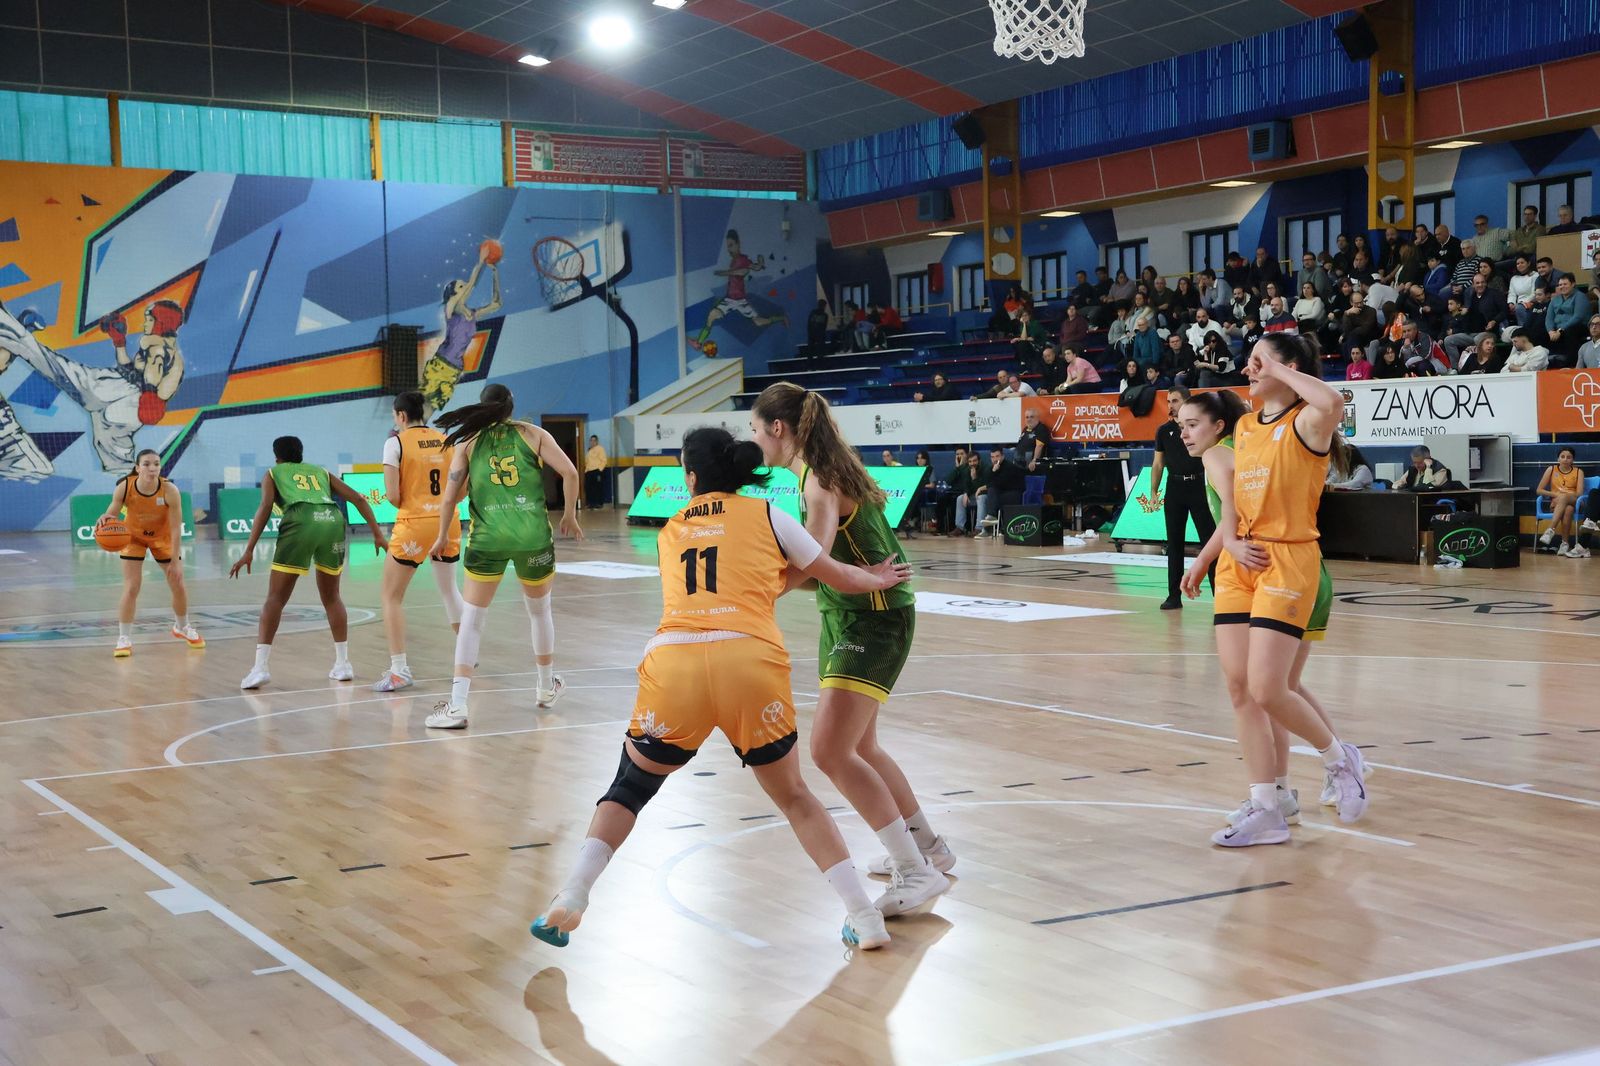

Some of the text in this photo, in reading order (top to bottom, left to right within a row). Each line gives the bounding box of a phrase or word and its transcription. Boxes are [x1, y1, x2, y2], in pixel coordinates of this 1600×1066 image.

[1370, 384, 1495, 420] ZAMORA
[1072, 423, 1123, 440] ZAMORA
[1371, 426, 1447, 438] AYUNTAMIENTO
[293, 473, 321, 491] 31
[430, 468, 441, 496] 8
[712, 501, 726, 515] M.
[680, 546, 718, 595] 11
